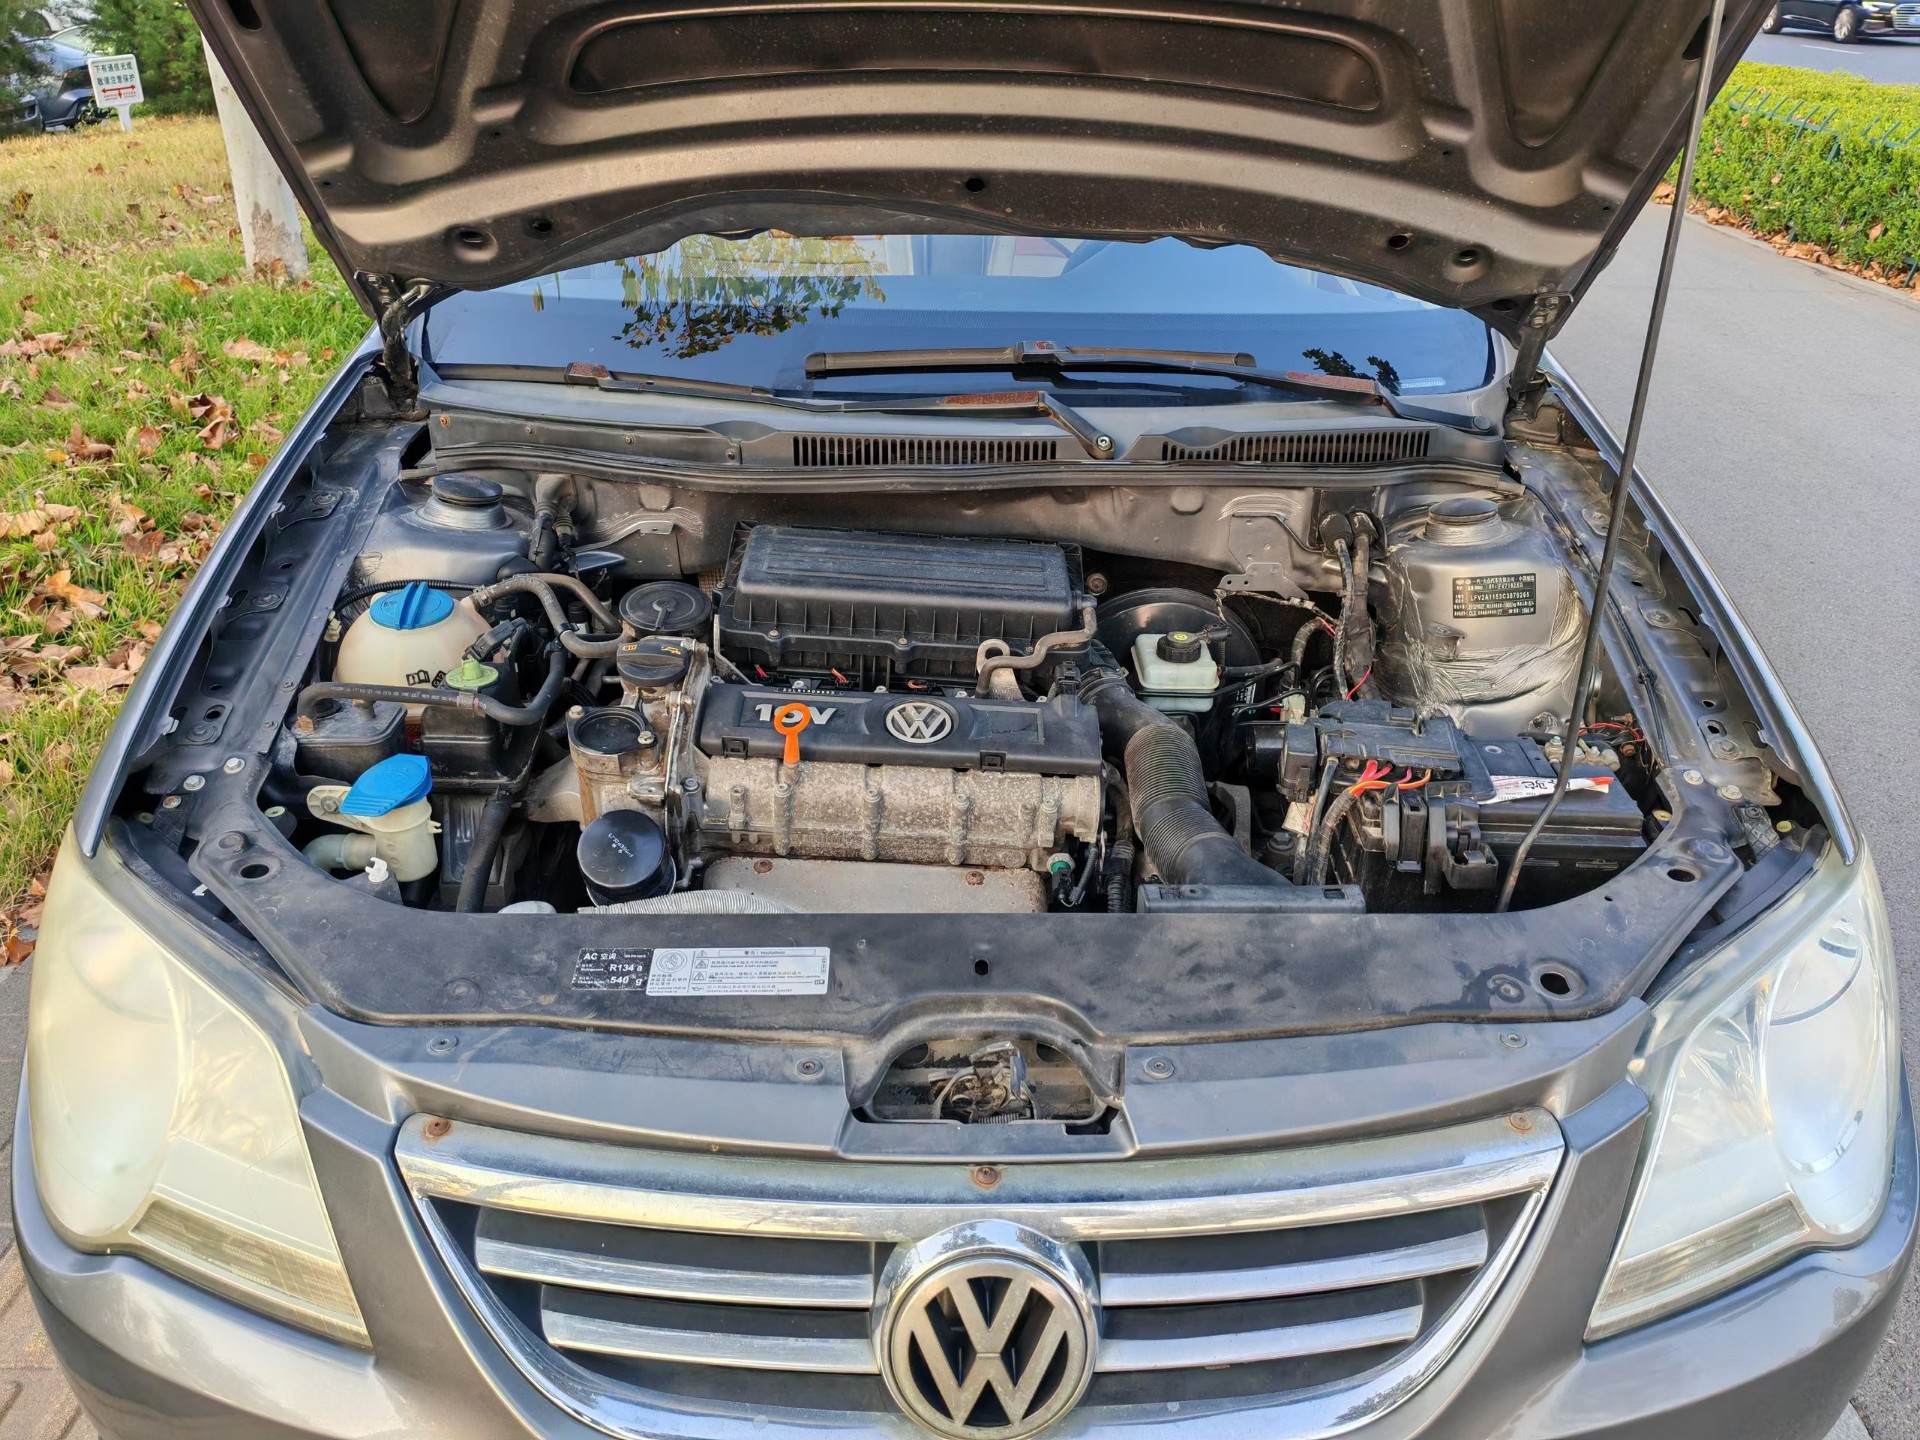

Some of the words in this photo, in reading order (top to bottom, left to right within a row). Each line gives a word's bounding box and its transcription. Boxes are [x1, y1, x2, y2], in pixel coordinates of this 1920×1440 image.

[97, 74, 135, 86] 敬请注意保护
[610, 976, 629, 984] 540
[891, 1258, 1087, 1439] VW
